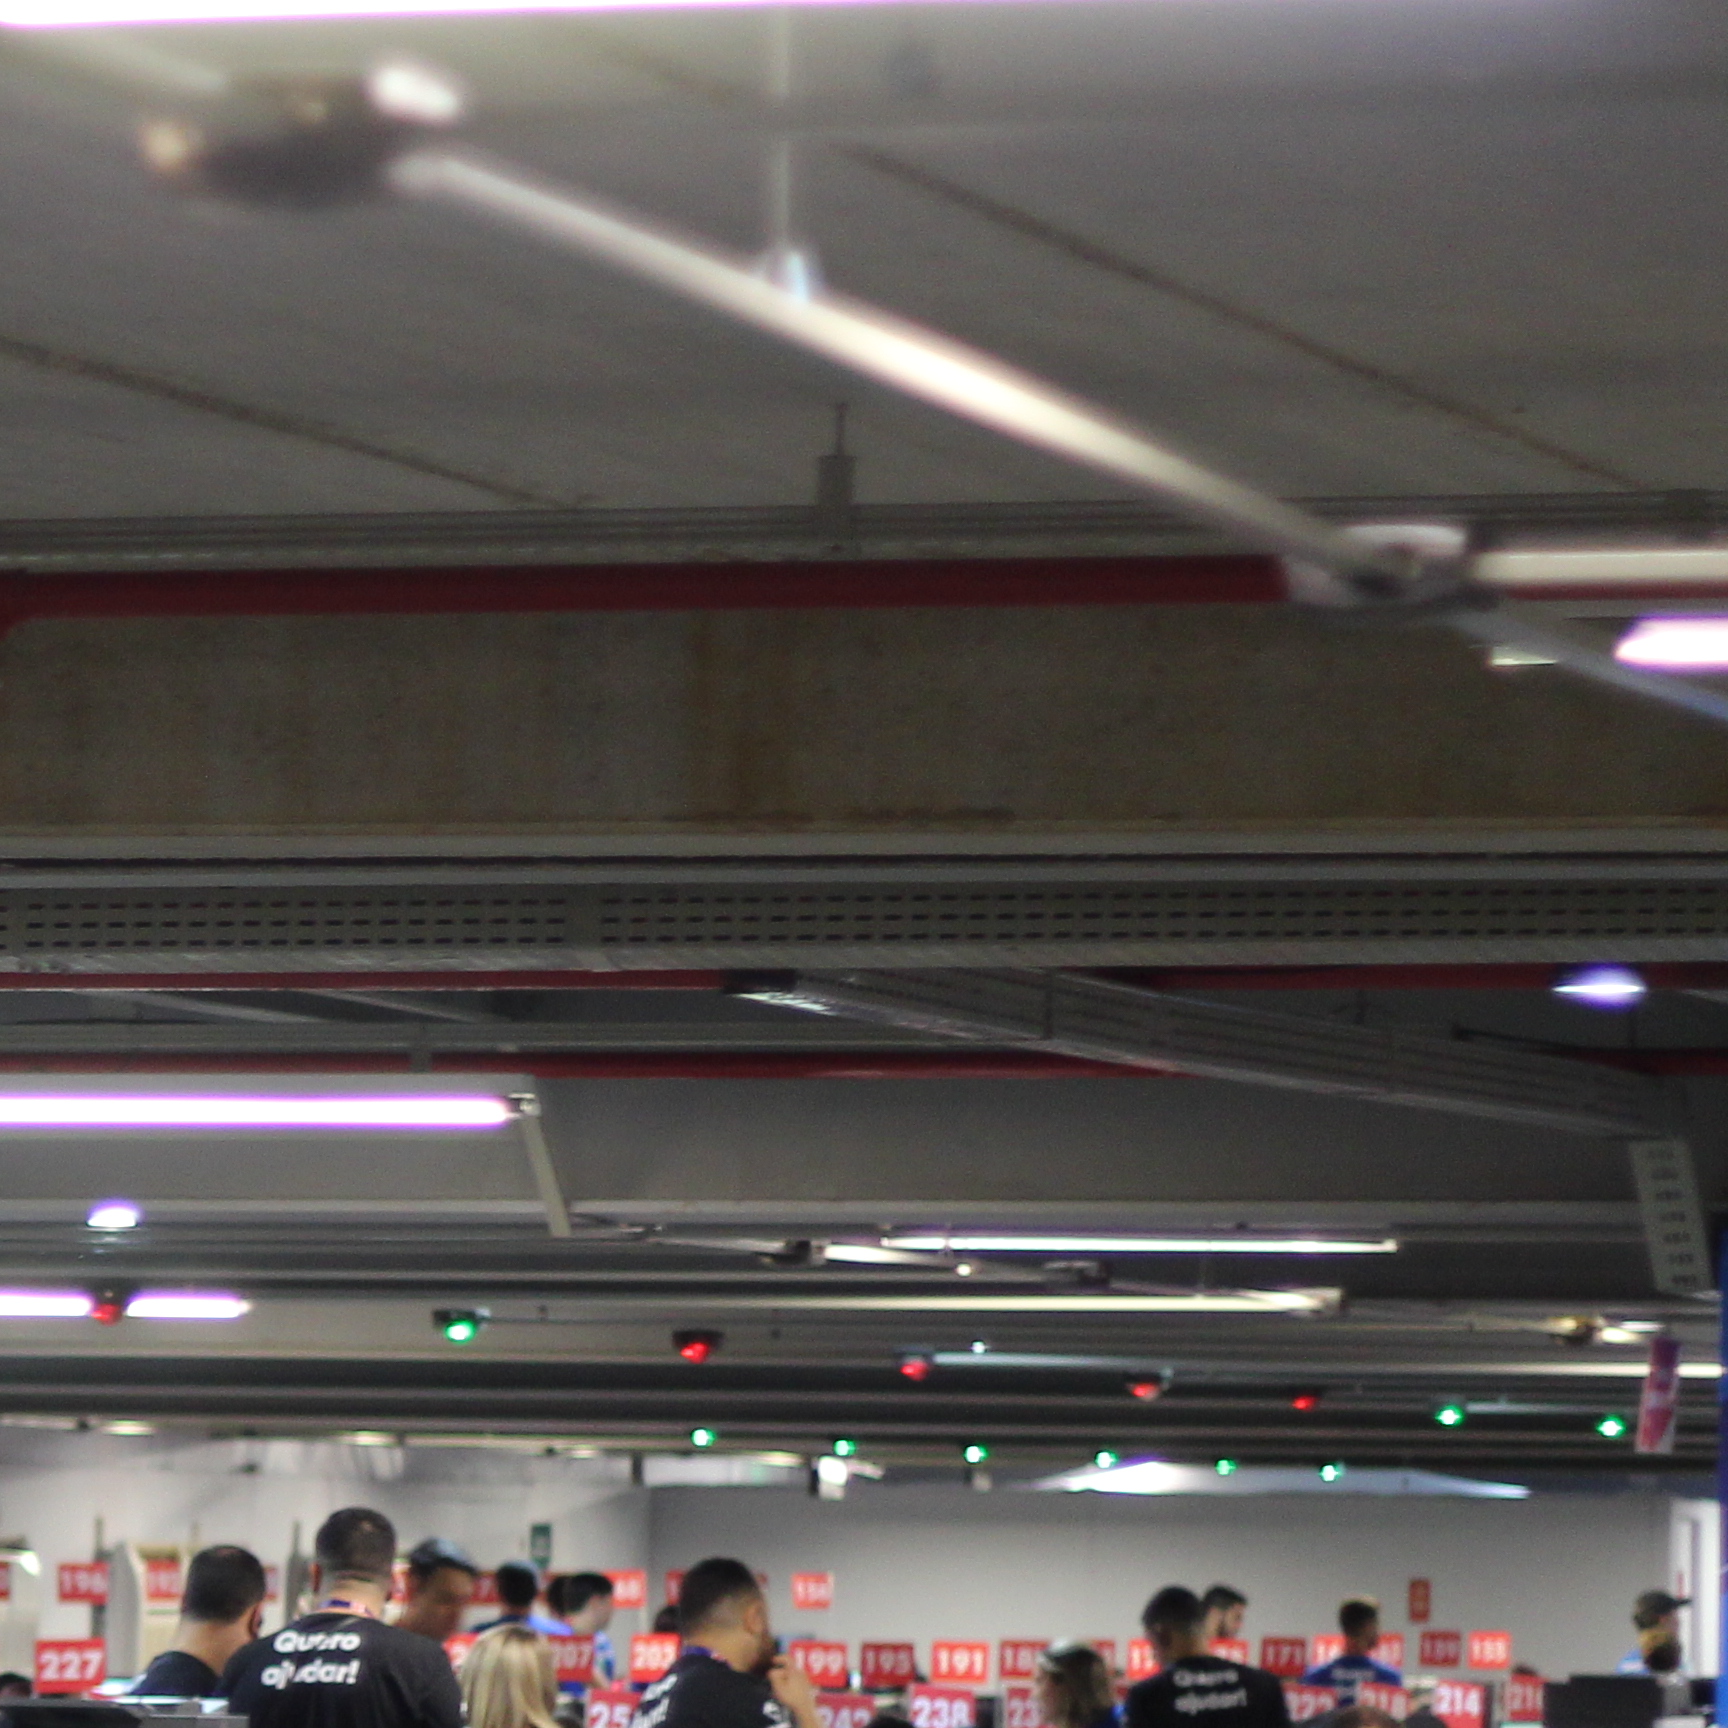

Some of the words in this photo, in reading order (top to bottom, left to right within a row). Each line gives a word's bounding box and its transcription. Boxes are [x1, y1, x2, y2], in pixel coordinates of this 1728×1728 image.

[39, 1649, 103, 1681] 227
[795, 1648, 844, 1676] 199
[938, 1648, 984, 1675] 191
[1433, 1685, 1481, 1717] 214
